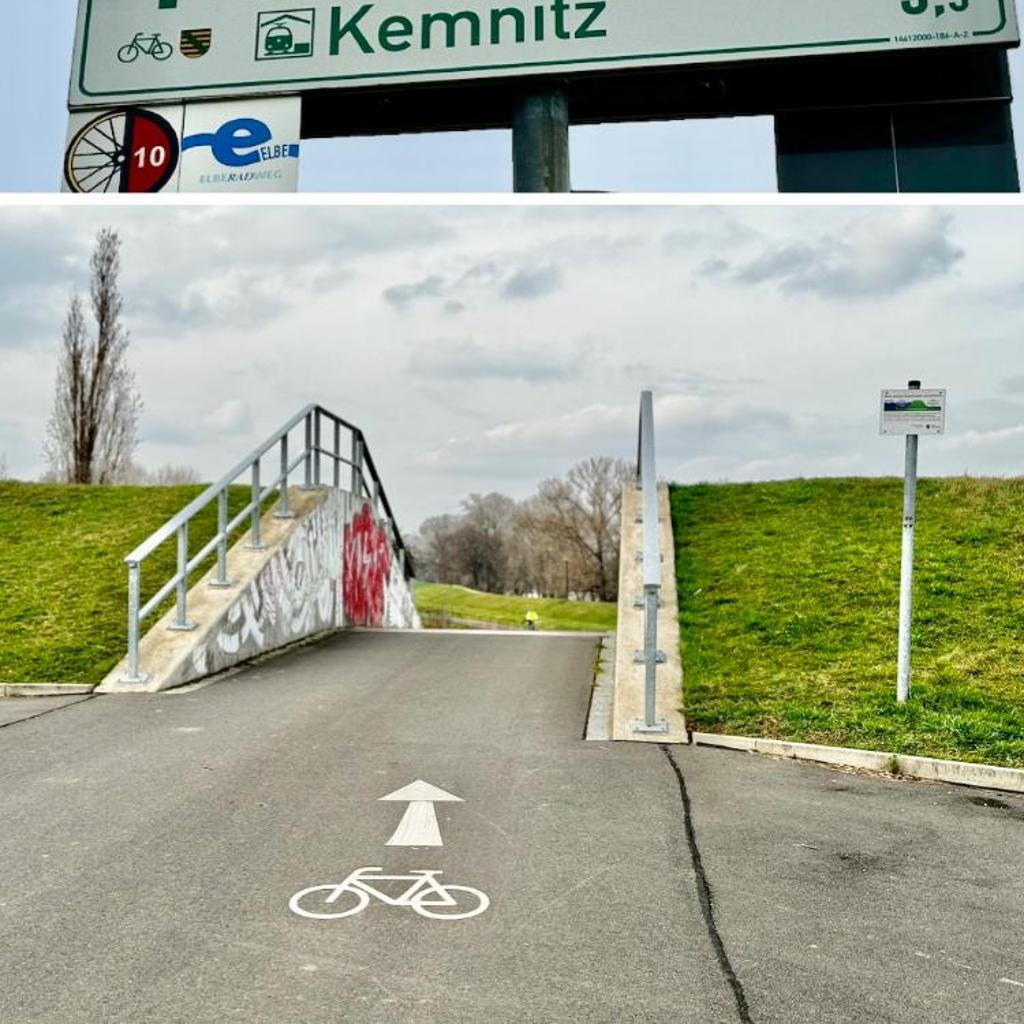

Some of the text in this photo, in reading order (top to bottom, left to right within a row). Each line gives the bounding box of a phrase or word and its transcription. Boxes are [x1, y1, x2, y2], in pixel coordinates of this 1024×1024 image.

[133, 145, 166, 168] 10
[260, 144, 288, 161] ELBE
[199, 170, 282, 184] ELBERADWEG
